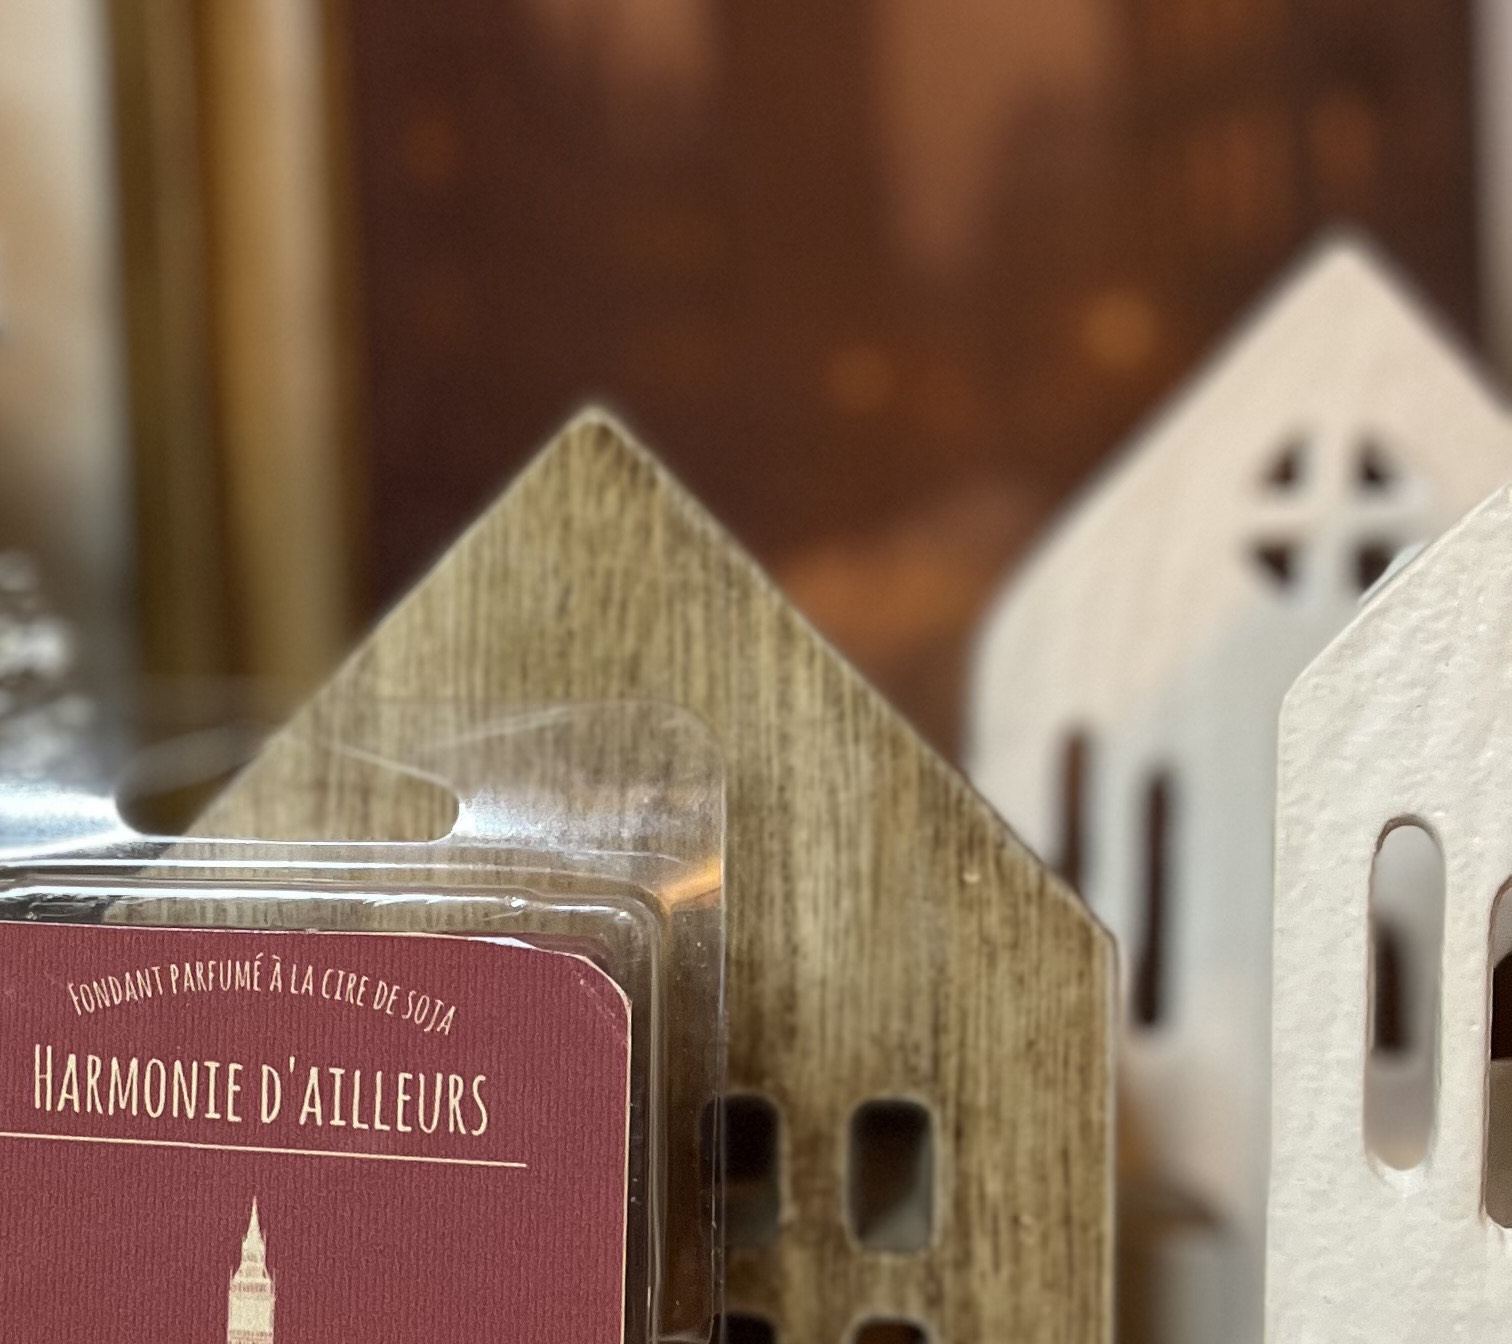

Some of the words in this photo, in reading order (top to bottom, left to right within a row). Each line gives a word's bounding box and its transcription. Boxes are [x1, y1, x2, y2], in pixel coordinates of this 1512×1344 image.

[67, 965, 164, 1016] FONDANT
[169, 952, 264, 995] PARFUMÉ
[269, 954, 283, 993] À
[290, 963, 314, 996] LA
[321, 968, 370, 1007] CIRE
[372, 979, 401, 1015] DE
[404, 990, 456, 1036] SOJA
[34, 1043, 244, 1123] HARMONIE
[260, 1055, 488, 1137] D'AILLEURS
